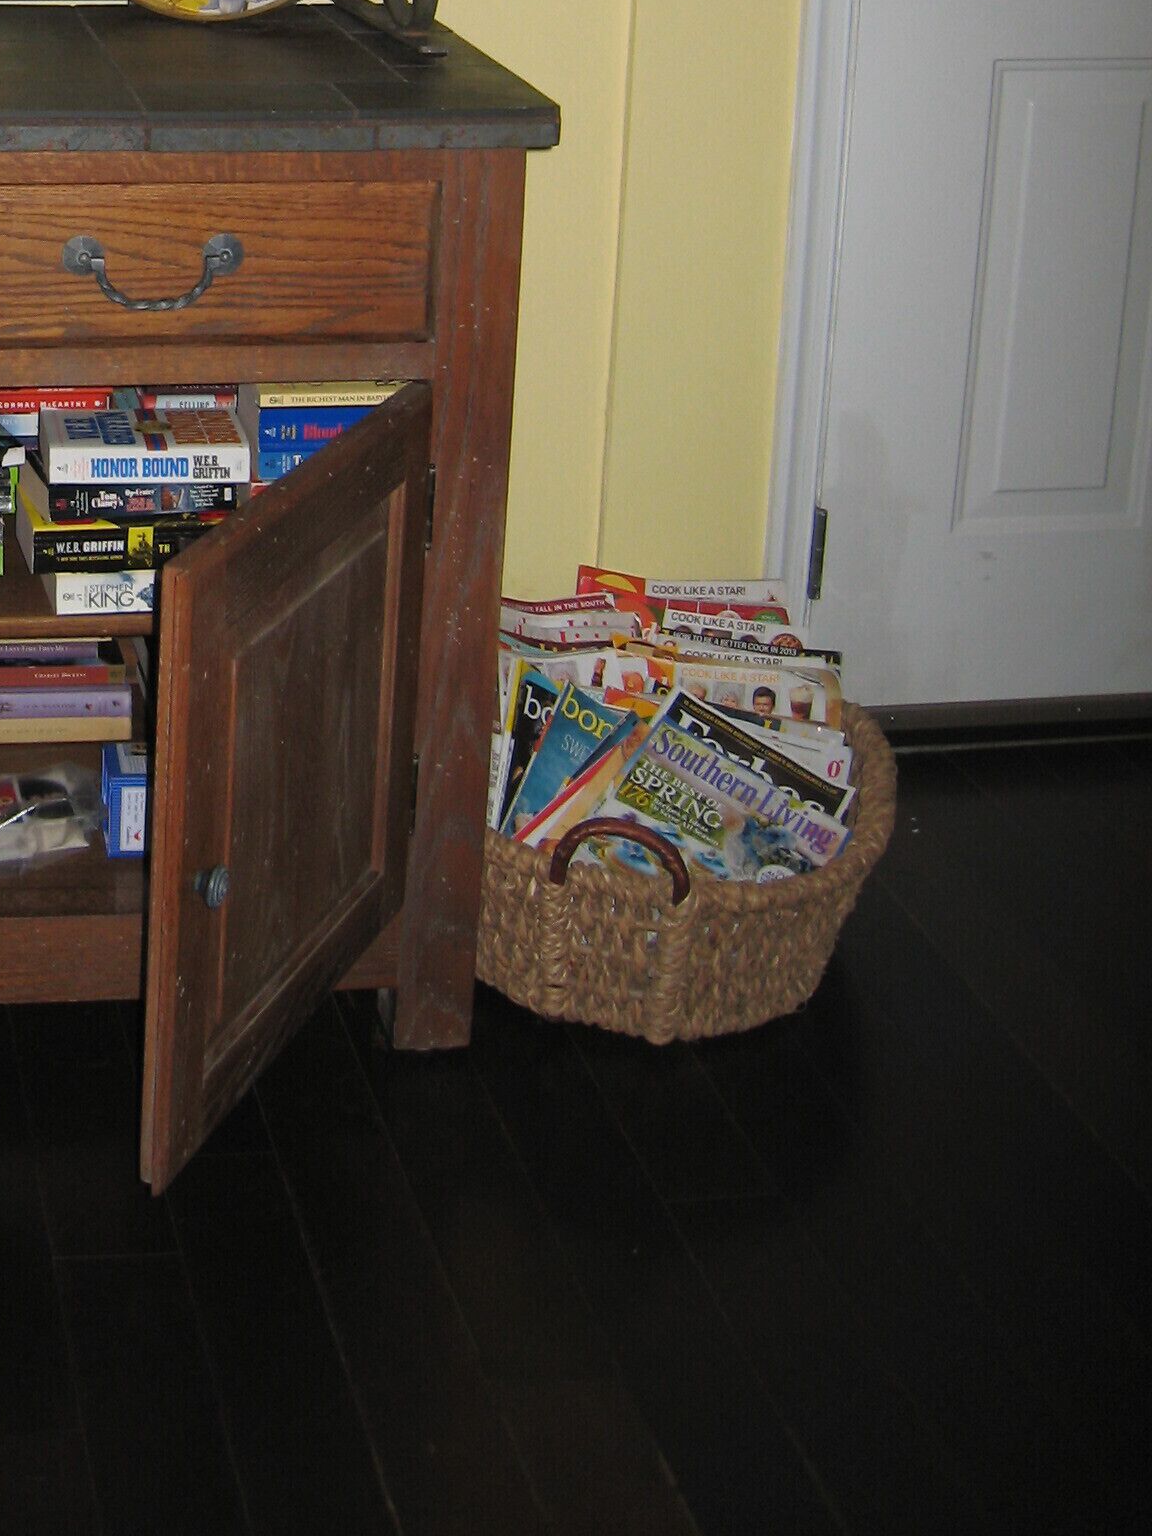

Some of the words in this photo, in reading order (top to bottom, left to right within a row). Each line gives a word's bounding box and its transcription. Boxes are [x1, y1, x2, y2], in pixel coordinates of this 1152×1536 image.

[338, 395, 356, 403] MAN
[91, 458, 139, 479] HONOR
[142, 458, 190, 478] BOUND
[193, 467, 231, 480] GRIFFIN
[83, 540, 125, 553] GRIFFIN
[89, 583, 133, 592] STEPHEN
[652, 584, 682, 595] COOK
[684, 585, 708, 595] LIKE
[708, 586, 715, 595] A
[717, 585, 746, 595] STAR!
[88, 592, 134, 608] KING
[534, 603, 553, 613] FALL
[554, 603, 563, 612] IN
[563, 601, 579, 611] THE
[580, 599, 606, 610] SOUTH
[671, 611, 701, 624] COOK
[702, 617, 726, 628] LIKE
[727, 619, 735, 629] A
[736, 620, 766, 633] STAR!
[721, 639, 748, 651] BETTER
[748, 643, 770, 653] COOK
[771, 646, 778, 654] IN
[682, 667, 713, 680] COOK
[714, 669, 738, 681] LIKE
[739, 671, 747, 682] A
[641, 760, 669, 780] THE
[674, 776, 707, 802] BEST
[706, 796, 722, 811] OF
[653, 728, 758, 809] Southern
[757, 787, 838, 856] Living
[630, 767, 724, 829] SPRING
